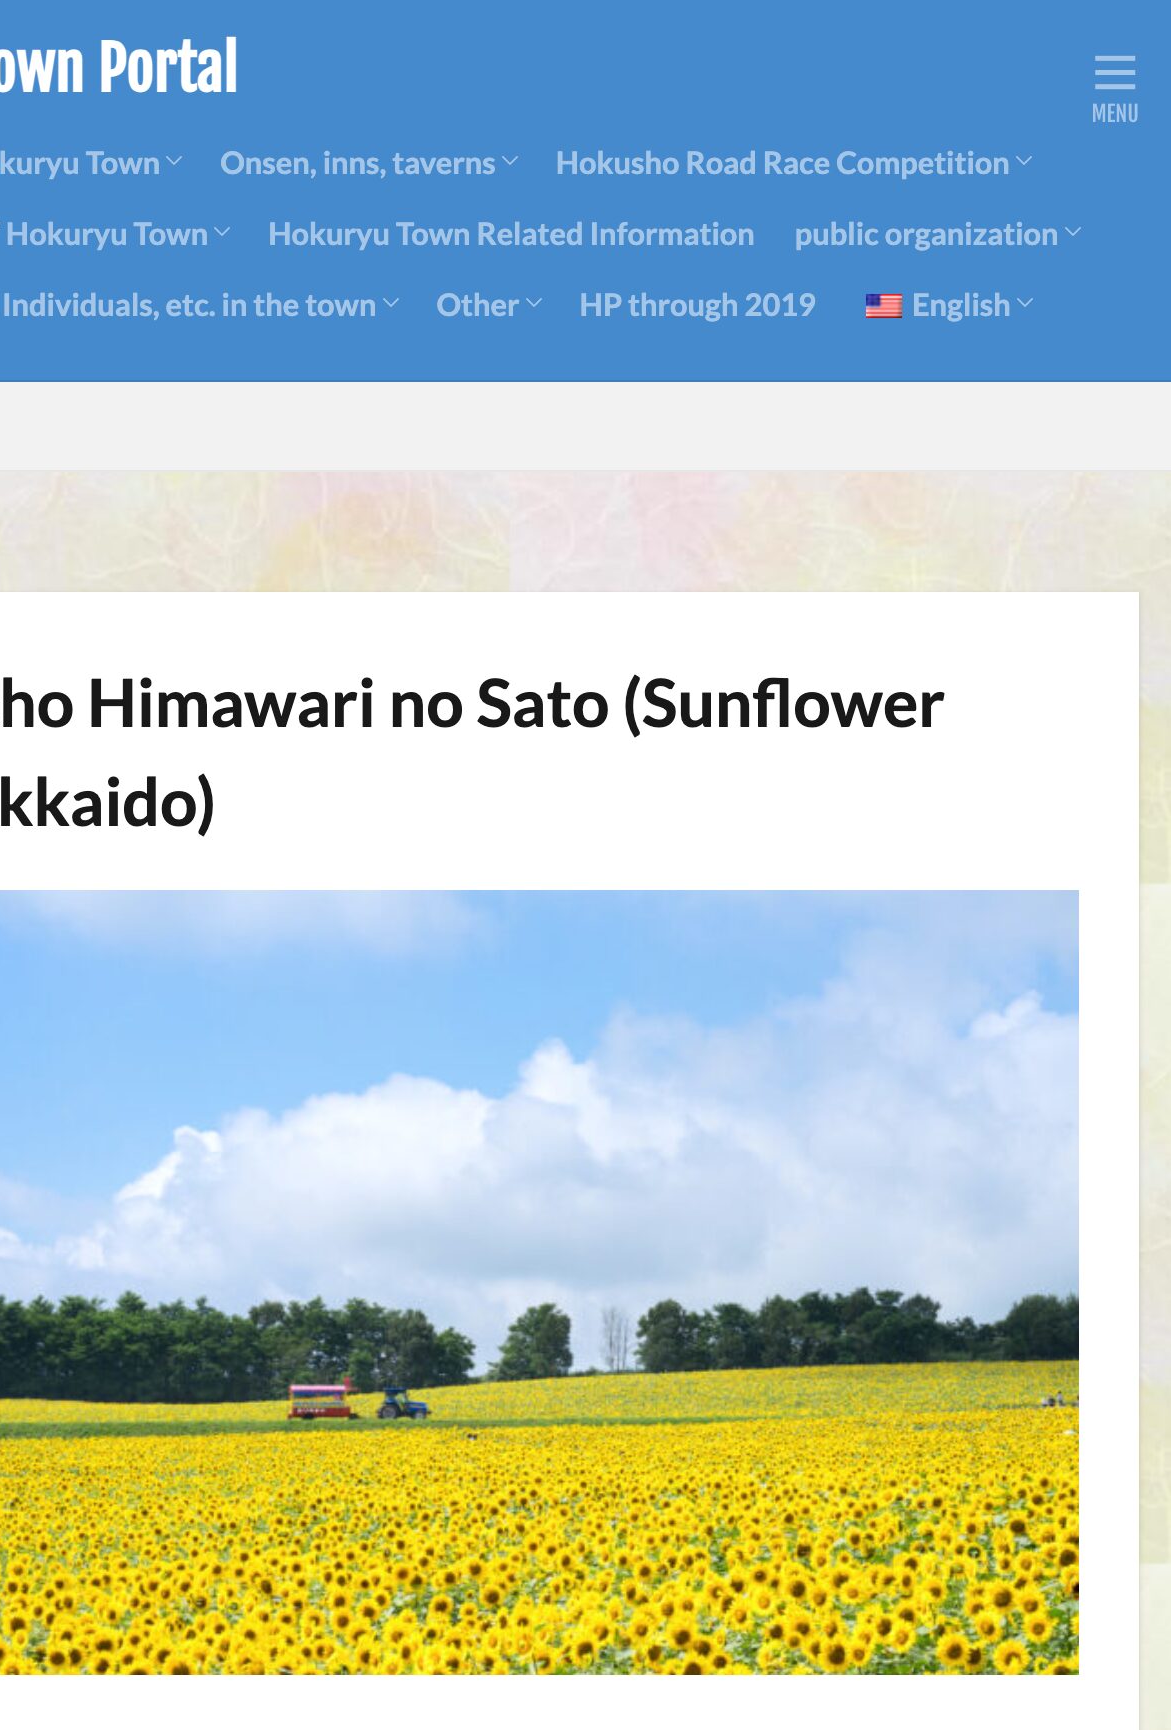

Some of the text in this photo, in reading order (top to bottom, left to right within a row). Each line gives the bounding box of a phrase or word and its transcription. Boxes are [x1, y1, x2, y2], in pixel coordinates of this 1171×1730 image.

[101, 35, 237, 93] Portal
[1093, 103, 1138, 122] MENU
[85, 151, 159, 175] Town
[221, 151, 495, 179] Onsen, inns, taverns
[557, 150, 1009, 180] Hokusho Road Race Competition
[7, 221, 126, 251] Hokuryu
[133, 222, 207, 246] Town
[270, 221, 754, 251] Hokuryu Town Related Information
[796, 221, 1057, 251] public organization
[4, 292, 375, 320] Individuals, etc. in the town
[437, 292, 519, 317] Other
[581, 292, 815, 322] HP through 2019
[914, 292, 1010, 322] English
[91, 675, 373, 728] Himawari
[392, 689, 462, 728] no
[477, 676, 608, 728] Sato
[625, 673, 945, 738] (Sunflower
